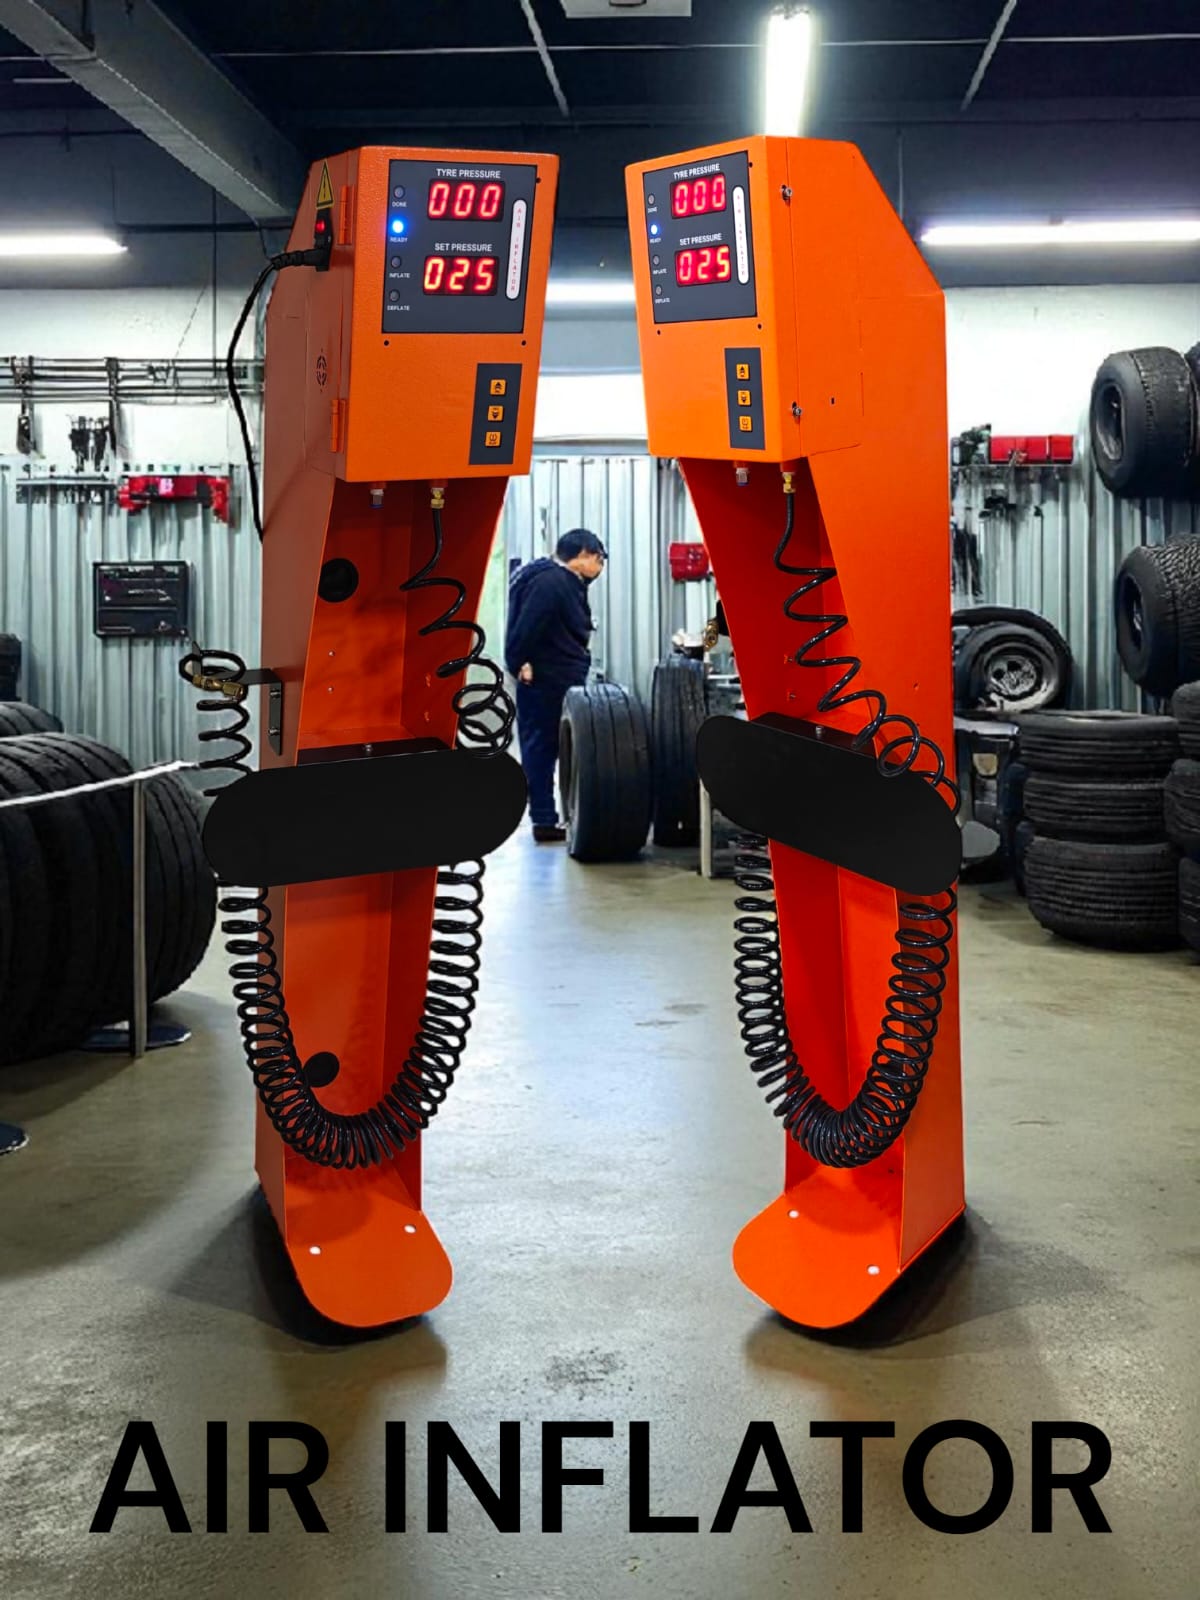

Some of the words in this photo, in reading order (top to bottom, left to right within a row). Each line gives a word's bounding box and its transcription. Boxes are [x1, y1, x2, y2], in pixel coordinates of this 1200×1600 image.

[436, 168, 457, 177] TYRE
[459, 169, 501, 179] PRESSURE
[674, 168, 688, 180] TYRE
[688, 163, 720, 177] PRESSURE
[428, 182, 501, 218] 000
[675, 175, 725, 214] 000
[434, 243, 450, 251] SET
[451, 243, 492, 252] PRESSURE
[679, 235, 691, 246] SET
[691, 233, 722, 245] PRESSURE
[423, 257, 496, 291] 025
[679, 246, 730, 281] 025
